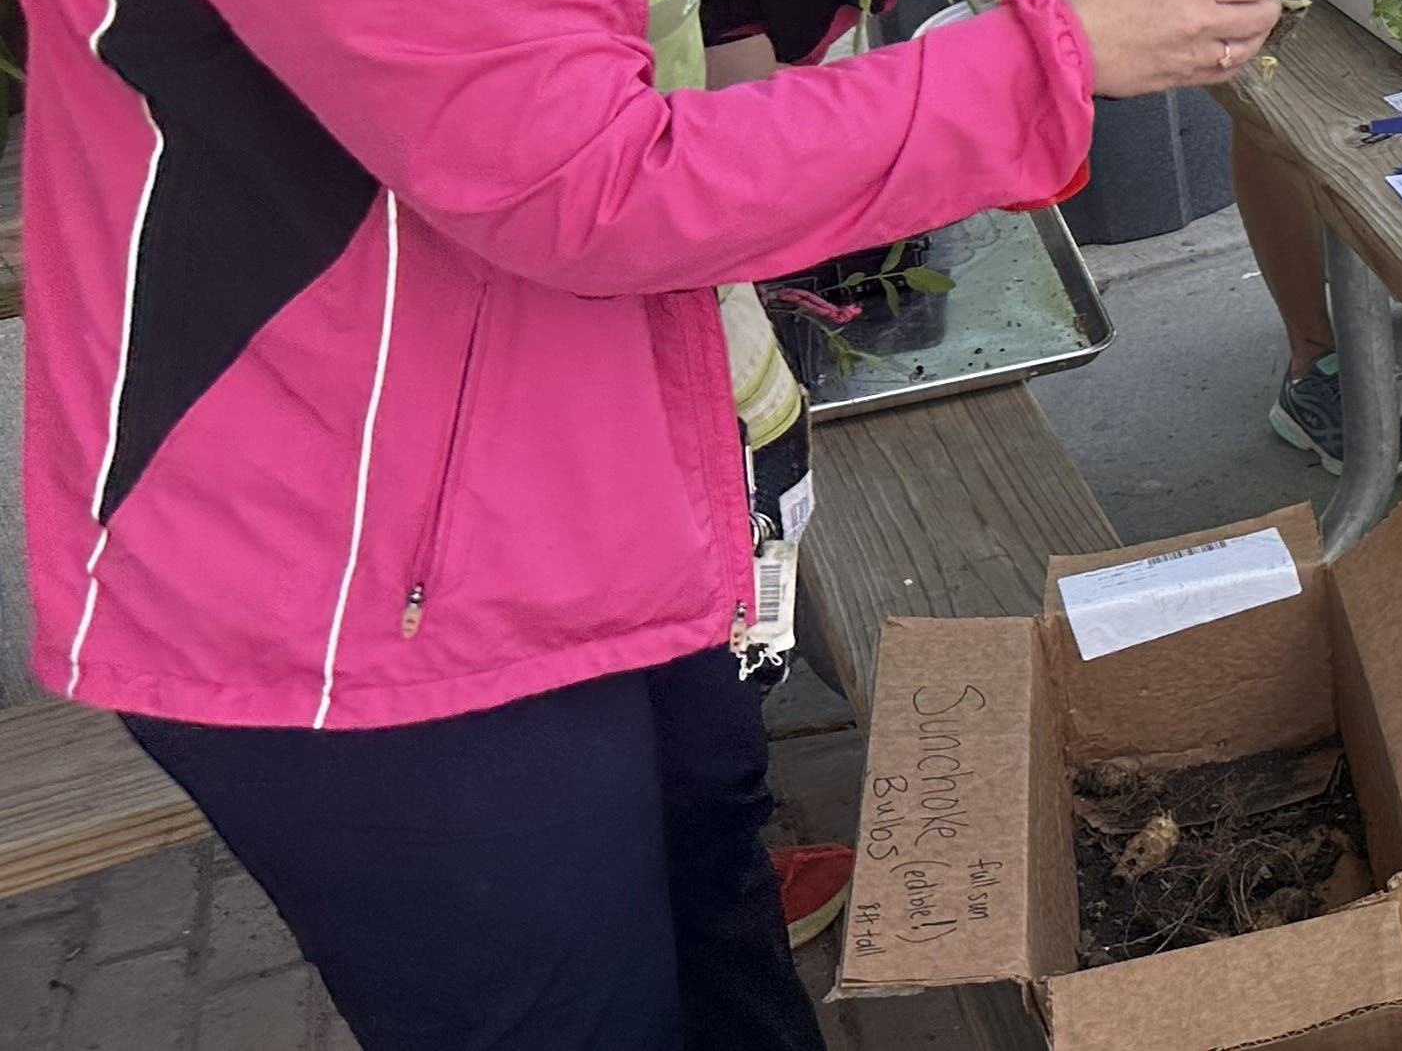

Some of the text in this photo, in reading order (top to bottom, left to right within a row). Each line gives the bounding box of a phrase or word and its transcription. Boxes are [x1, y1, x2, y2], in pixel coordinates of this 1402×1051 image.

[866, 774, 909, 861] Bulbs
[890, 685, 986, 943] Sunchoke (edible!)
[968, 859, 1003, 921] full sun
[854, 930, 886, 958] tall
